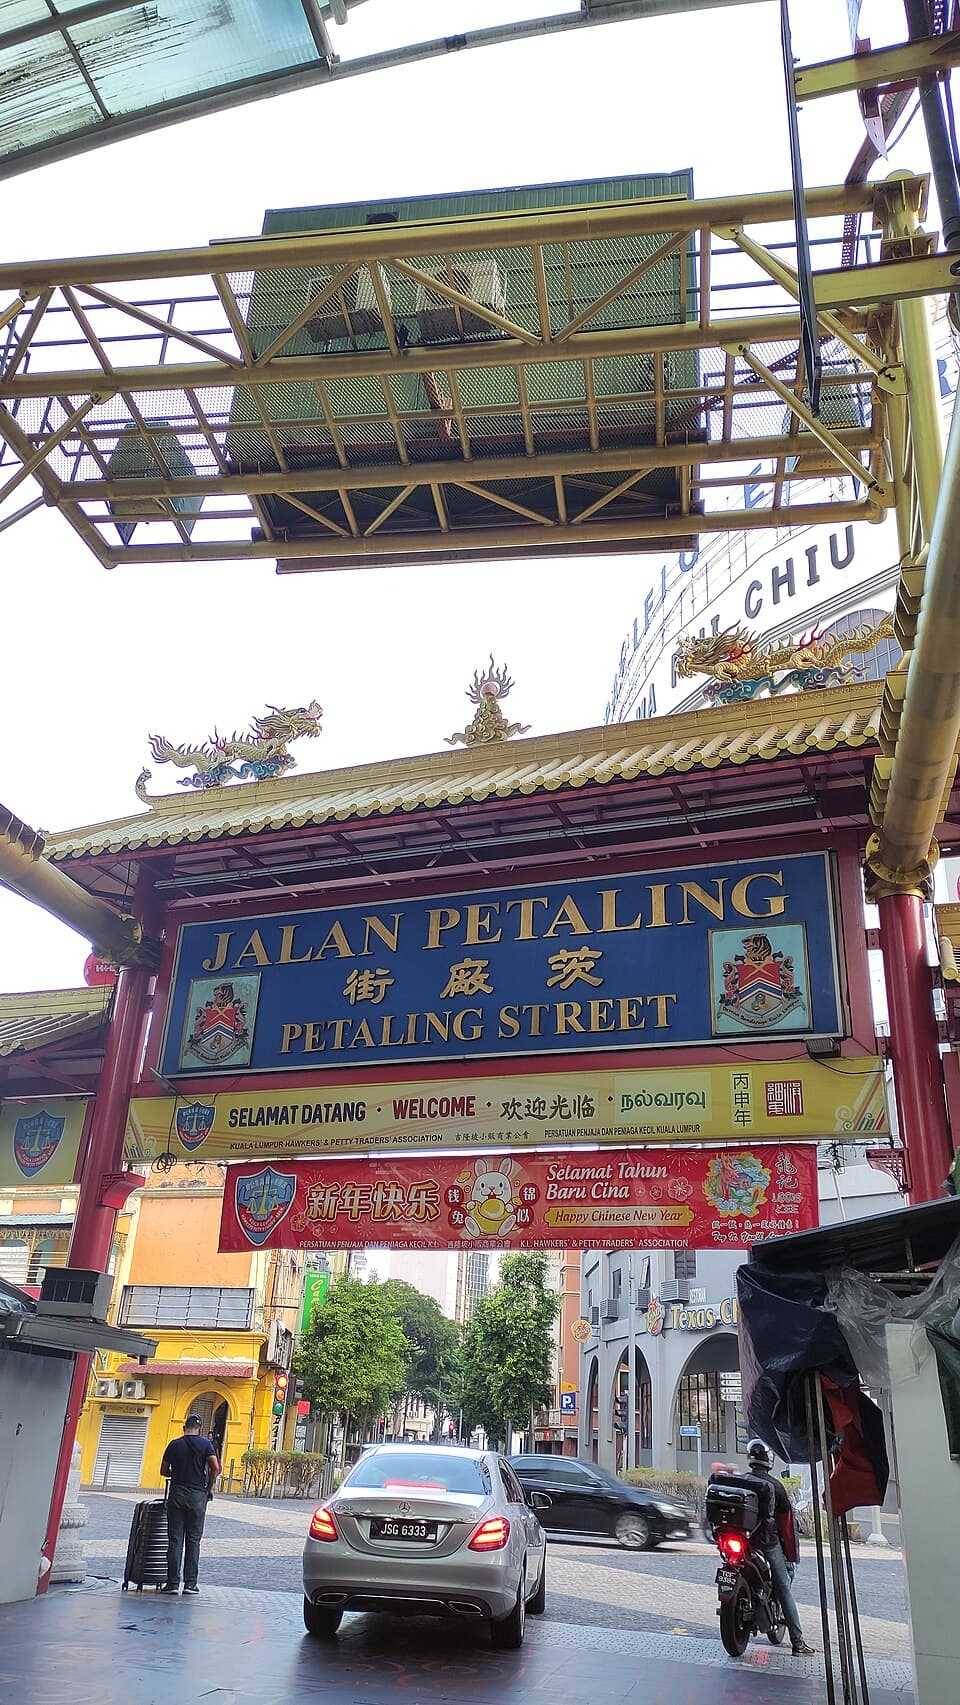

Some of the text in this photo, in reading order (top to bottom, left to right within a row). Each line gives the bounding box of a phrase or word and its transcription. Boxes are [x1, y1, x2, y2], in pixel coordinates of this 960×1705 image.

[744, 525, 856, 619] CHIU
[202, 869, 790, 972] JALAN PETALING
[280, 1007, 484, 1054] PETALING
[497, 993, 678, 1039] STREET
[392, 1096, 476, 1120] WELCOME
[499, 1094, 596, 1121] 欢迎光临
[731, 1072, 752, 1127] 丙申年
[229, 1105, 300, 1128] SELAMAT
[301, 1101, 367, 1123] DATANG
[544, 1124, 701, 1138] PERSATUAN PENJAJA DAN PENIAGA KECIL KUALA LUMPUR
[230, 1141, 254, 1150] KUALA
[254, 1140, 284, 1150] LUMPUR
[323, 1139, 329, 1147] &
[331, 1138, 354, 1147] PETTY
[392, 1134, 443, 1144] ASSOCIATION
[547, 1162, 668, 1181] Selamat Tahun
[305, 1180, 440, 1222] 新年快乐
[547, 1182, 629, 1200] Baru Cina
[555, 1208, 683, 1224] Happy Chinese New Year
[299, 1240, 337, 1249] PERSATUAN
[364, 1240, 379, 1248] DAN
[380, 1240, 408, 1249] PENIAGA
[409, 1239, 426, 1248] KECIL
[571, 1239, 578, 1247] &
[578, 1239, 601, 1248] PETTY
[638, 1239, 689, 1248] ASSOCIATION
[671, 1305, 716, 1331] Texas
[562, 1395, 572, 1408] P
[380, 1523, 399, 1535] JSG
[401, 1524, 427, 1537] 6333
